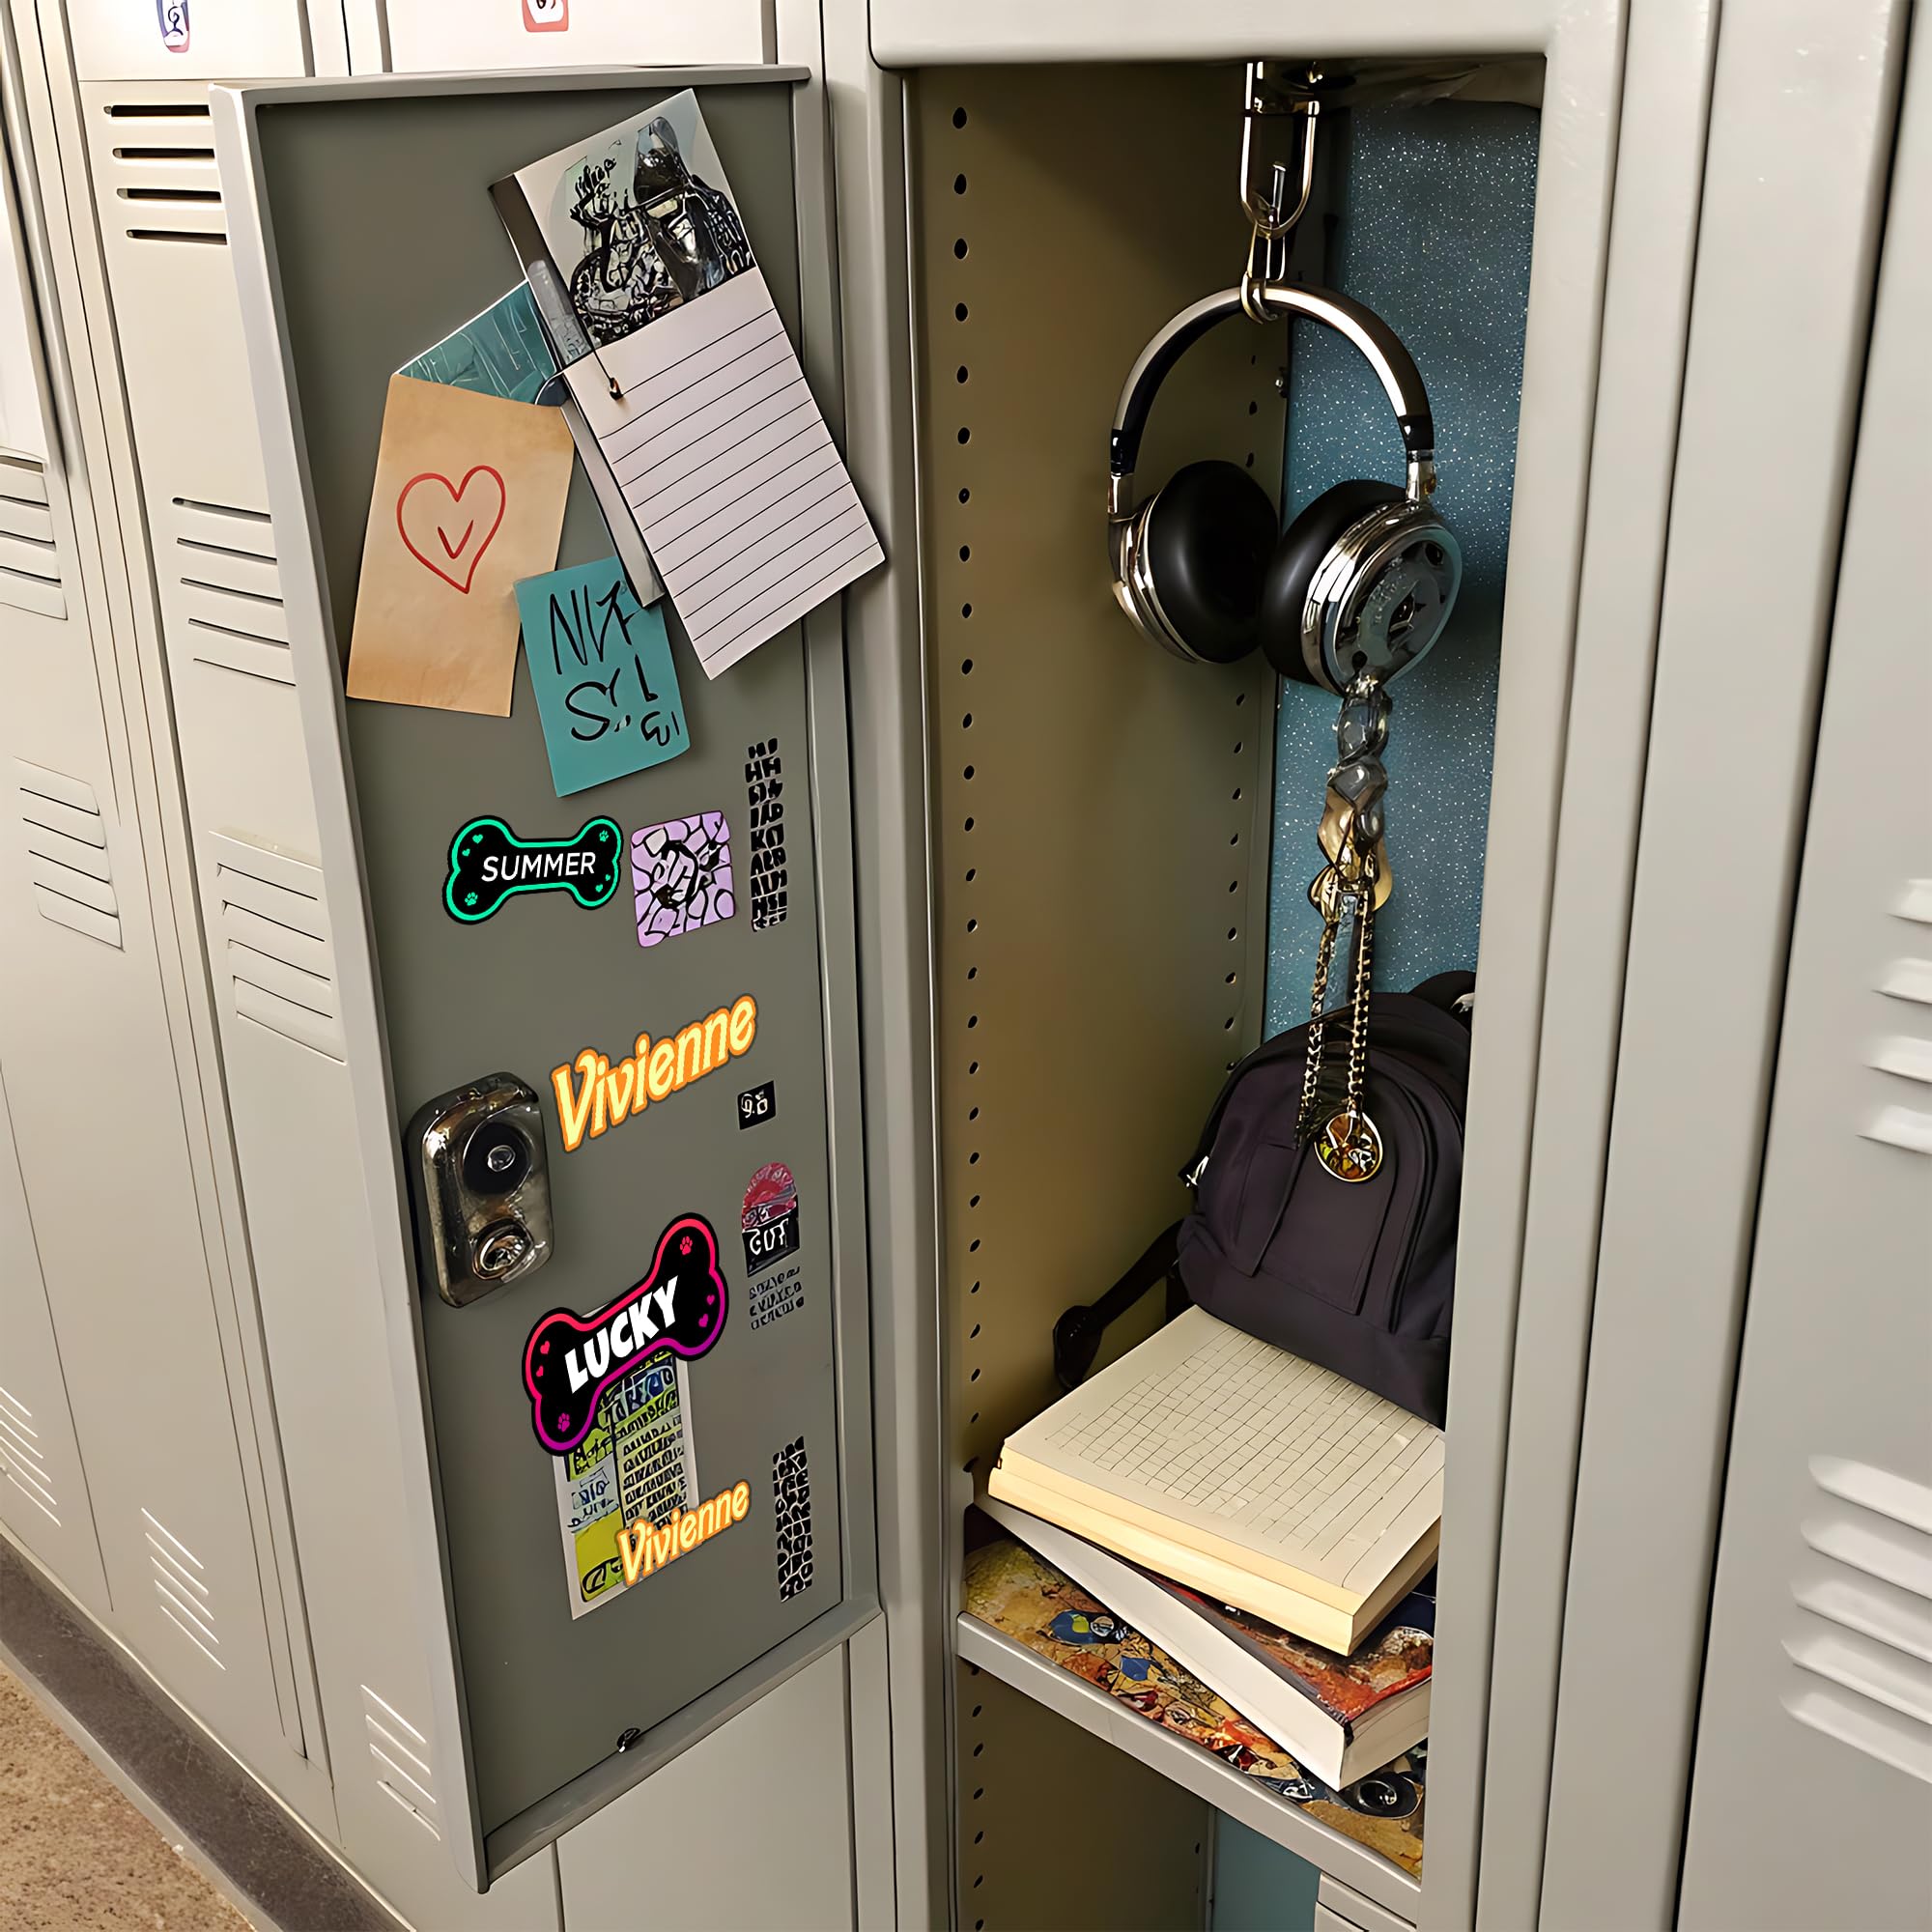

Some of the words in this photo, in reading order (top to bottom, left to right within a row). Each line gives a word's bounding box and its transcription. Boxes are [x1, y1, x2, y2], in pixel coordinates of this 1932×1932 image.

[481, 852, 596, 882] SUMMER
[552, 995, 756, 1151] Vivienne
[564, 1275, 678, 1394] LUCKY
[617, 1481, 750, 1585] Vivienne
